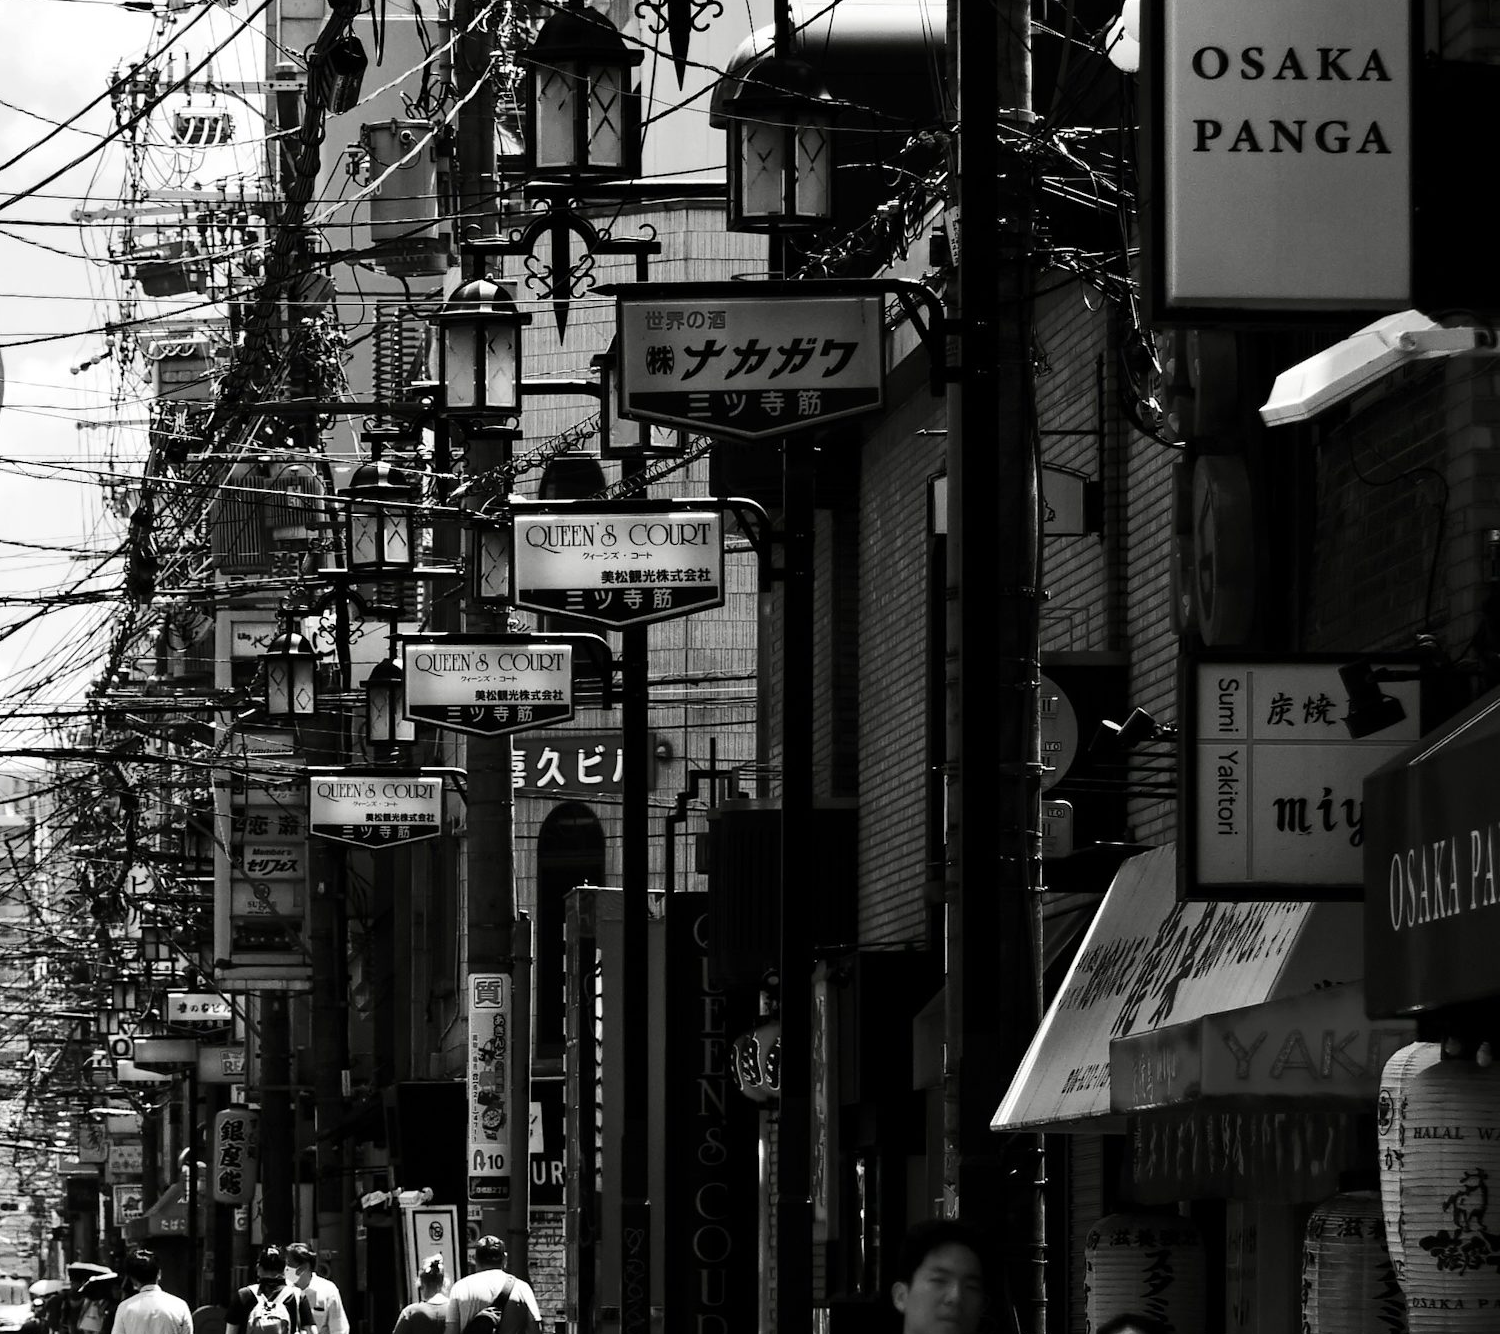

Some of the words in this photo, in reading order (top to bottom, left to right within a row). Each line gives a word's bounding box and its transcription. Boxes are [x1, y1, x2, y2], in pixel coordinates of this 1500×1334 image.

[1191, 44, 1392, 83] OSAKA
[1191, 117, 1392, 156] PANGA
[645, 310, 727, 331] 世界の酒
[687, 390, 822, 418] 三ツ寺筋
[526, 522, 617, 554] QUEEN'S
[628, 522, 711, 547] COURT
[601, 568, 712, 584] 美松観光株式会社
[565, 589, 674, 611] 三ツ寺筋
[414, 651, 491, 675] QUEEN'S
[498, 653, 565, 672] COURT
[474, 689, 565, 702] 美松観光株式会社
[1217, 677, 1239, 733] Sumi
[445, 705, 535, 723] 三ツ寺筋
[1266, 691, 1355, 728] 炭焼
[315, 781, 378, 803] QUEEN'S
[381, 783, 436, 800] COURT
[1217, 750, 1239, 836] Yakitori
[341, 825, 411, 841] 三ツ寺筋
[1389, 835, 1460, 932] OSAKA
[1470, 819, 1500, 910] PA
[475, 981, 501, 1005] 質
[1413, 1127, 1464, 1140] HALAL
[488, 1154, 504, 1170] 10
[1141, 1249, 1175, 1331] スタミ
[1411, 1297, 1464, 1310] OSAKA
